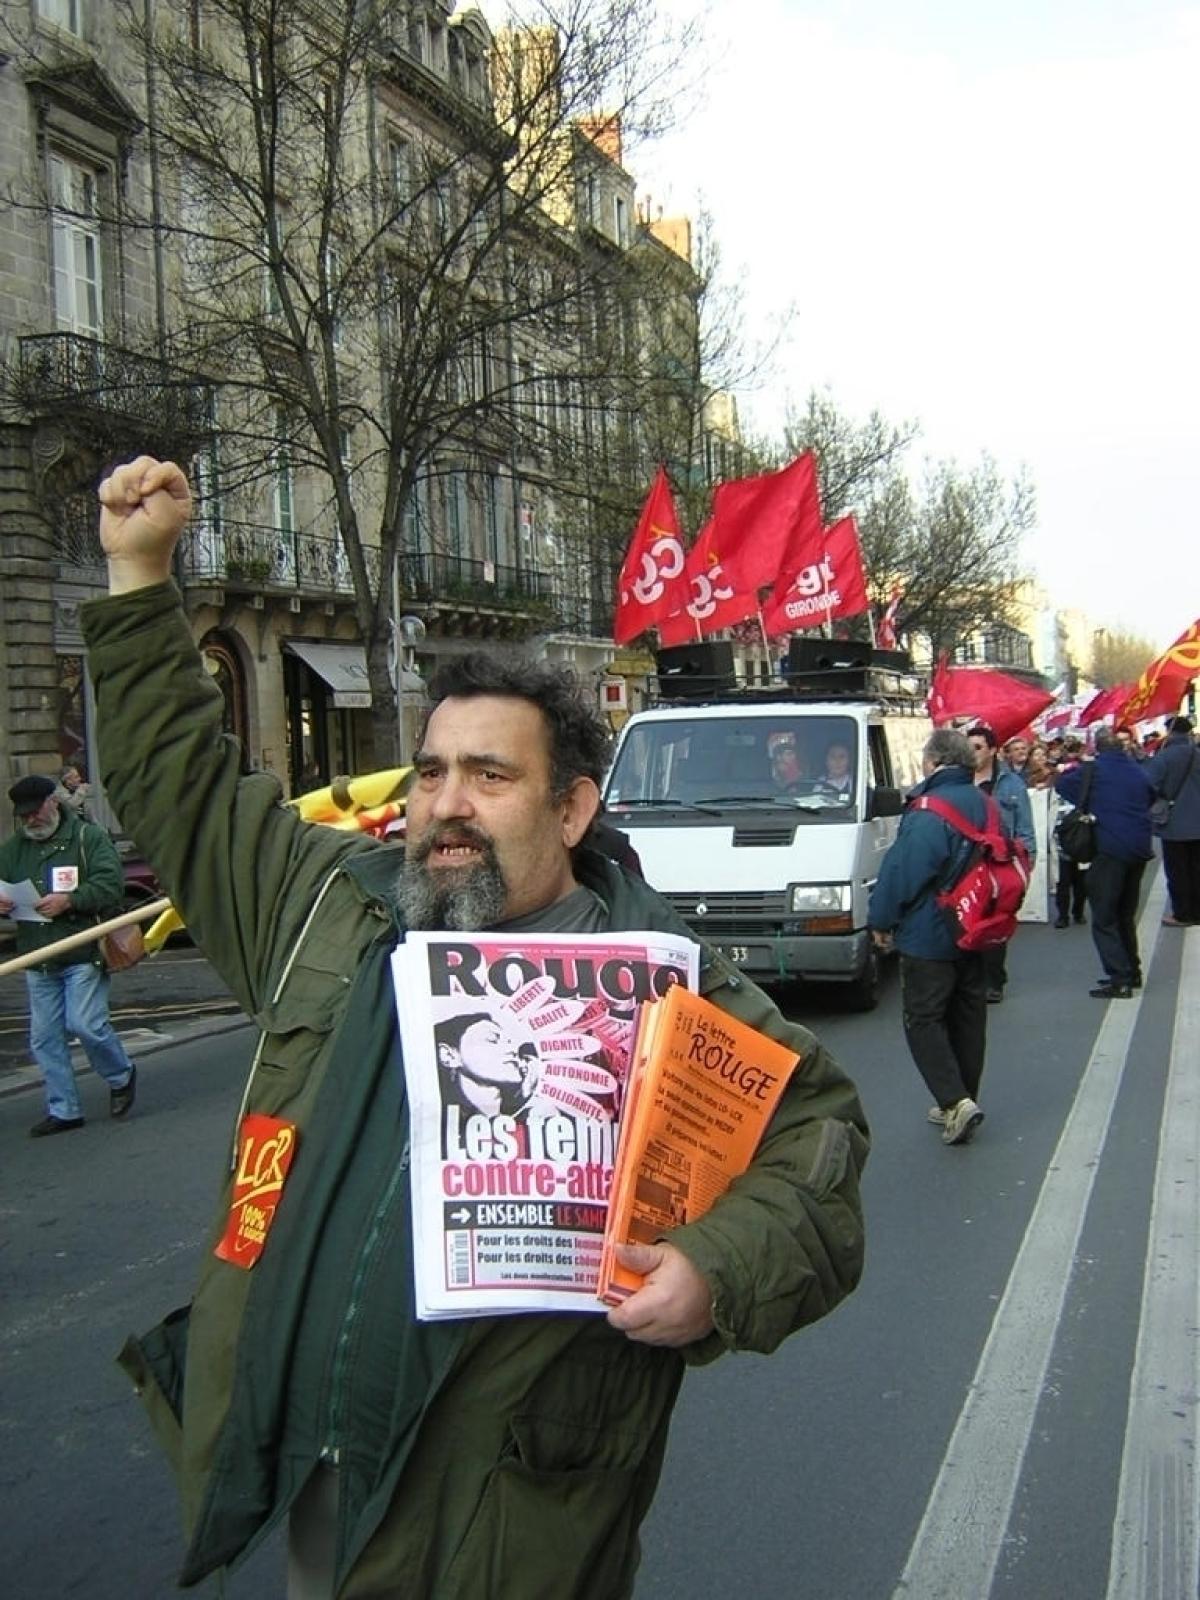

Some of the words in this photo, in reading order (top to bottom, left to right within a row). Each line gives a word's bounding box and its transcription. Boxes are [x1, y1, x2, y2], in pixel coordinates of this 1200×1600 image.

[785, 589, 841, 620] GIRONDE
[732, 946, 748, 962] 33
[544, 1063, 610, 1088] AUTONOMIE
[688, 1033, 779, 1101] ROUGE
[447, 1104, 518, 1160] Les
[526, 1105, 617, 1161] fem
[236, 1127, 293, 1187] LCR
[477, 1203, 554, 1226] ENSEMBLE
[557, 1205, 572, 1225] LE
[477, 1235, 501, 1247] Pour
[504, 1234, 521, 1246] les
[523, 1235, 553, 1247] droits
[555, 1236, 573, 1248] des
[477, 1252, 502, 1263] Pour
[505, 1251, 521, 1263] les
[524, 1252, 554, 1264] droits
[555, 1253, 573, 1265] des
